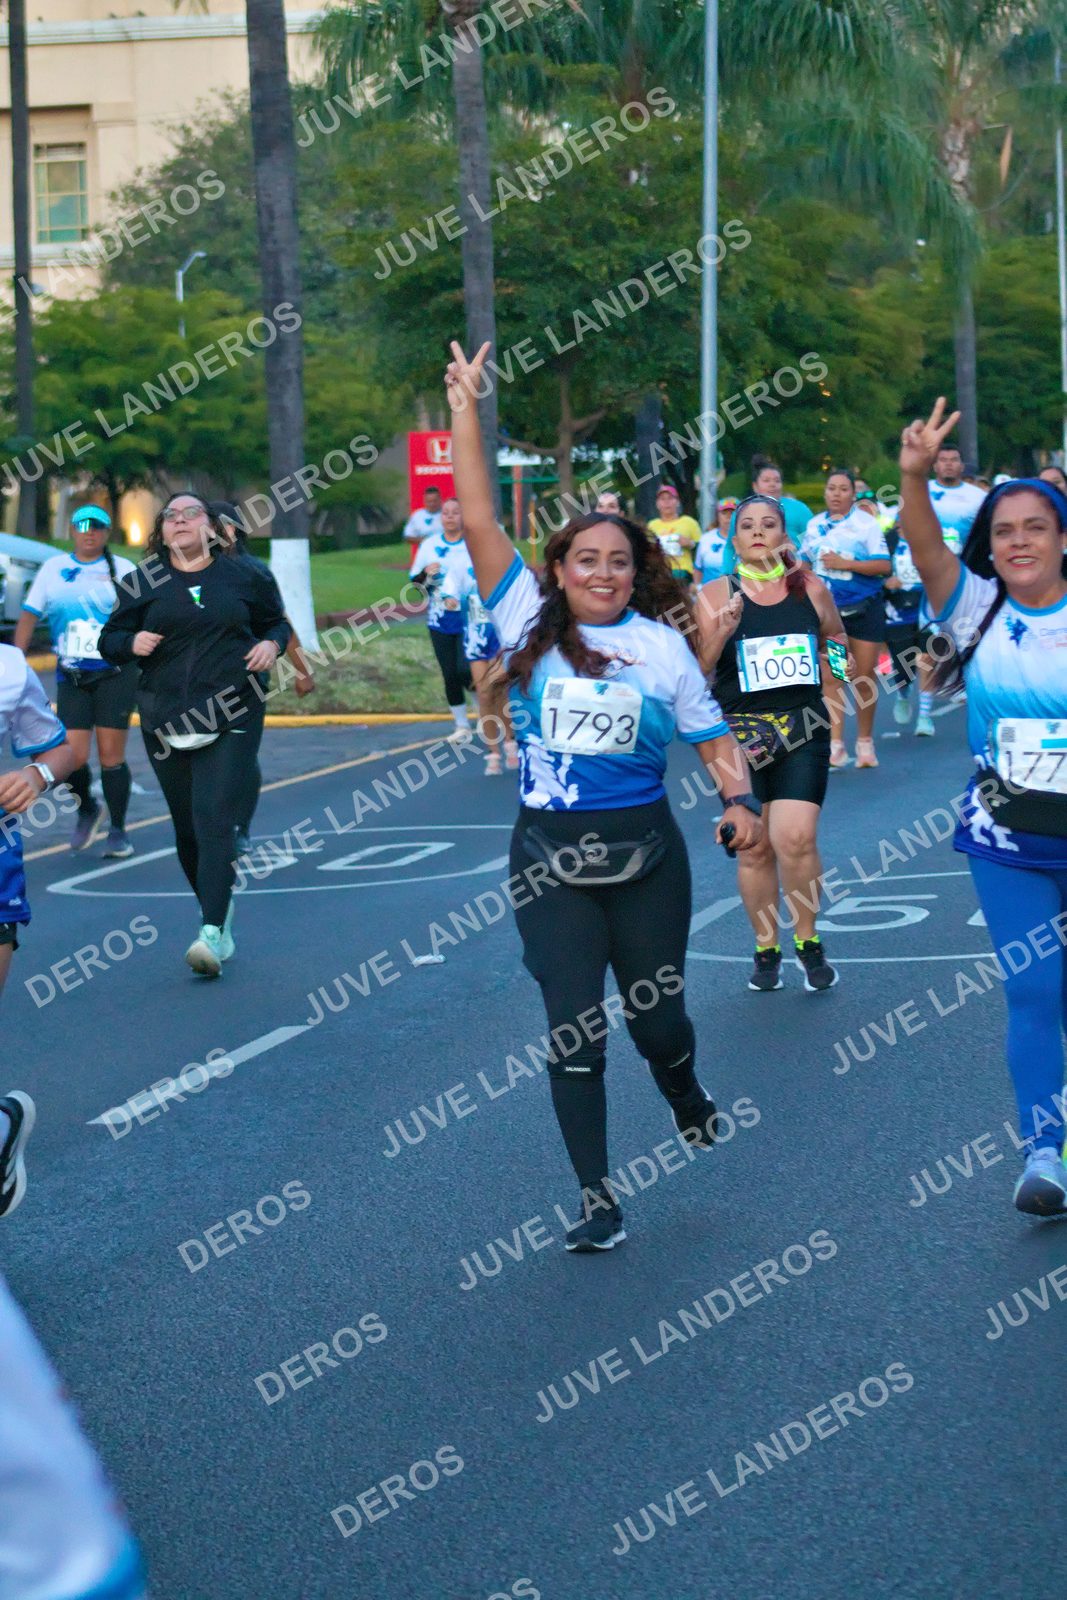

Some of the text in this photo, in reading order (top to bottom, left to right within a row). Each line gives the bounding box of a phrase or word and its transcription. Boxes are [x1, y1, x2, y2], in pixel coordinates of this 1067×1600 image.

[76, 636, 97, 653] 16
[750, 655, 811, 683] 1005
[548, 707, 635, 745] 1793
[1005, 750, 1067, 783] 177
